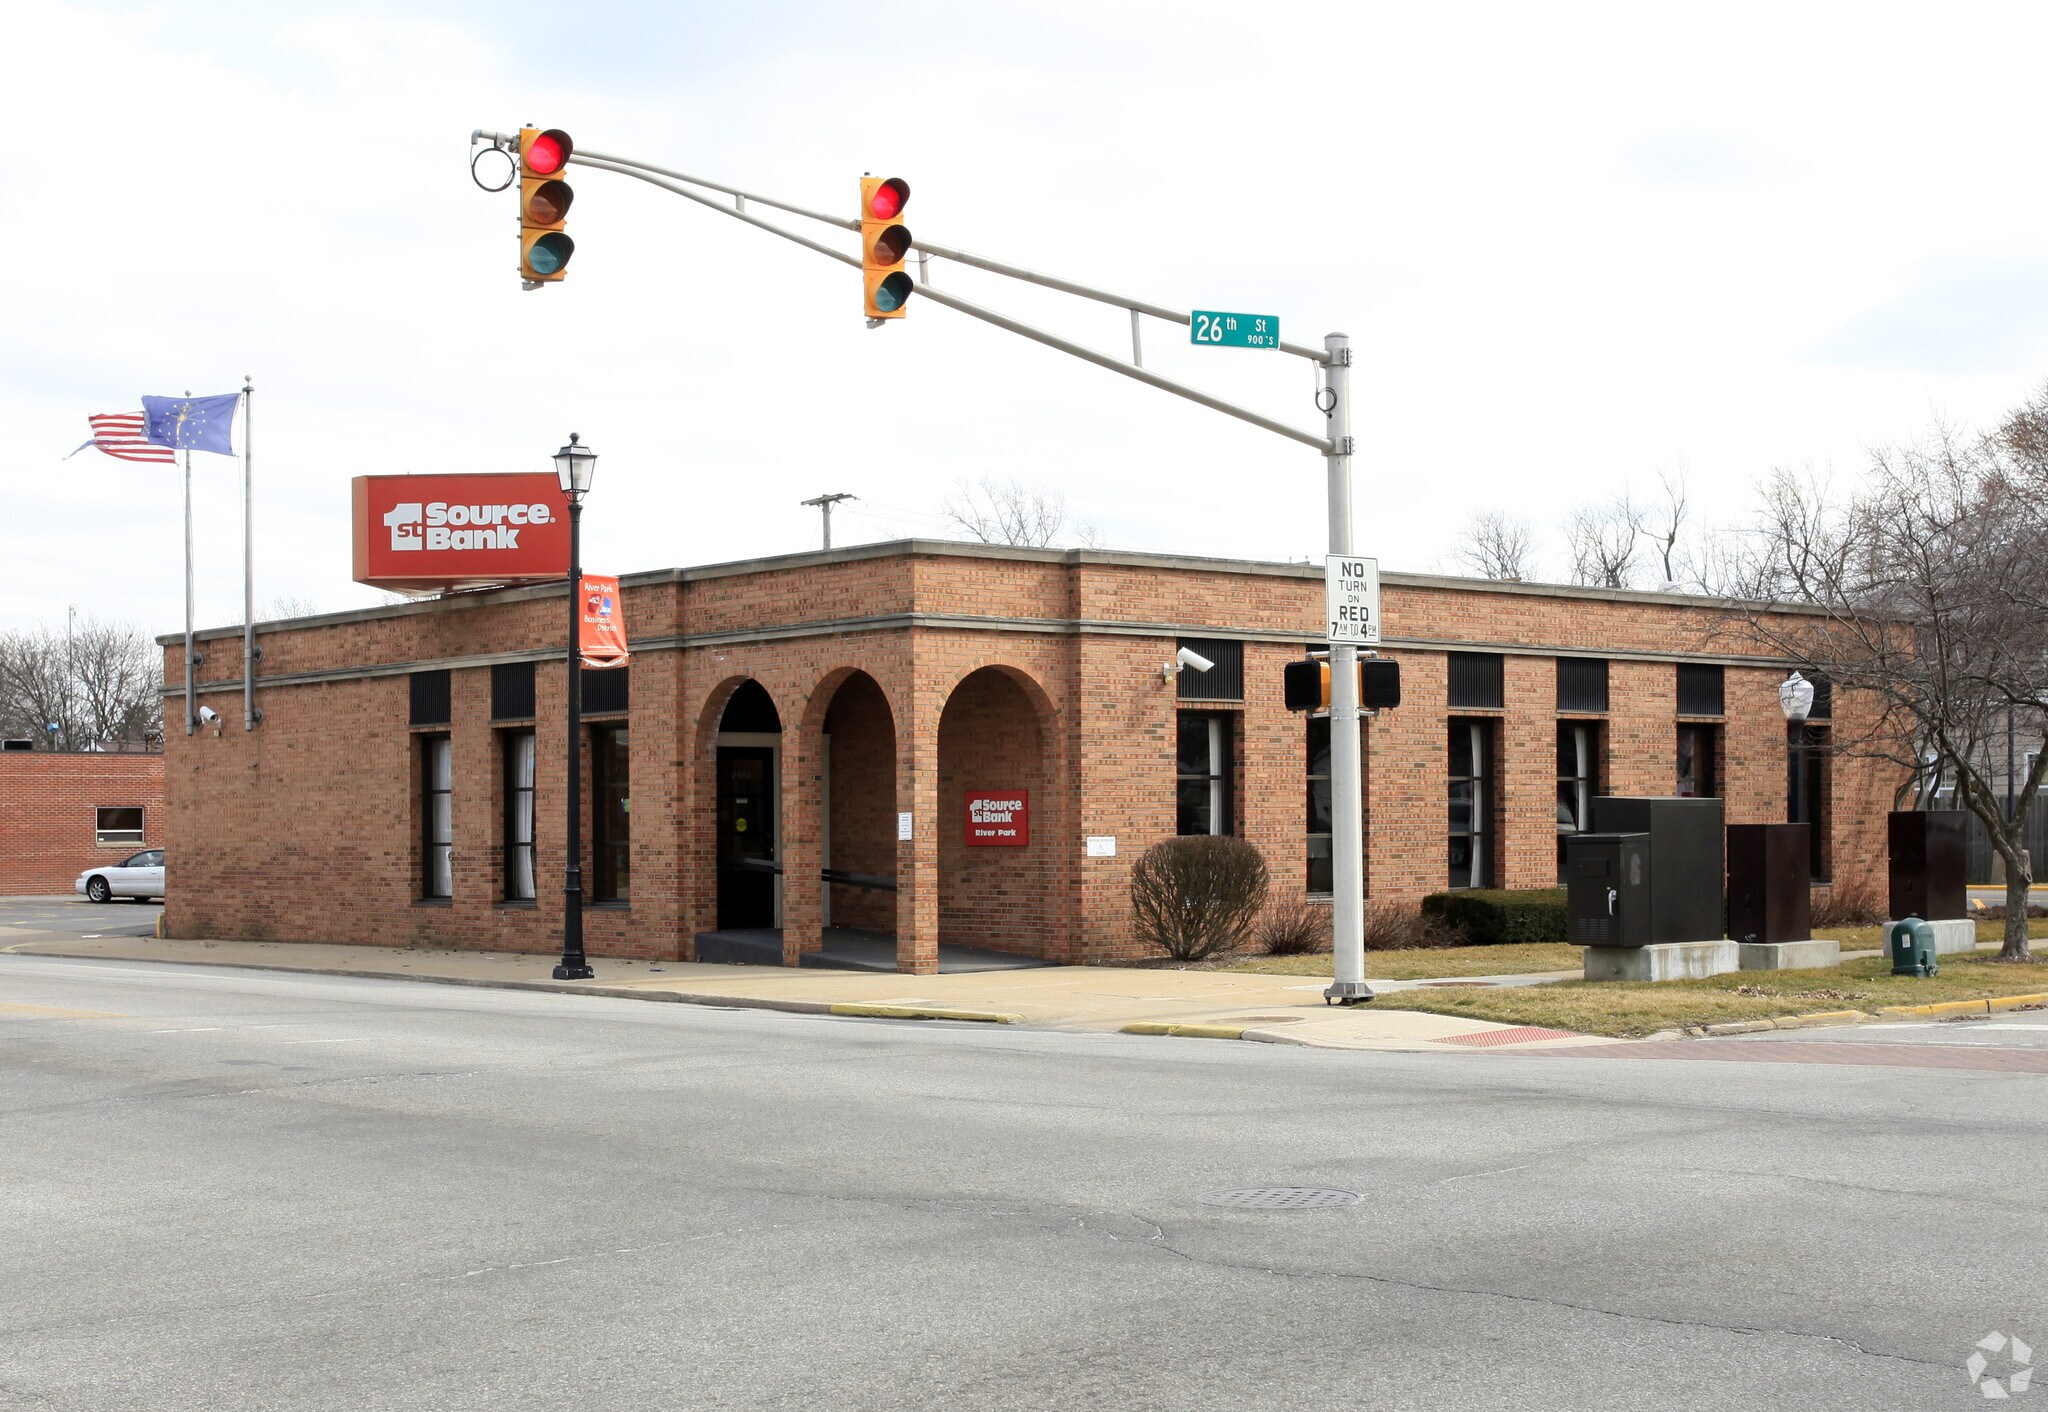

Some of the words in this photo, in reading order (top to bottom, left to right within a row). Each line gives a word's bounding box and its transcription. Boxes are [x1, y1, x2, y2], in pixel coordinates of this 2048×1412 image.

[1196, 315, 1237, 342] 26th
[1255, 319, 1267, 333] St
[1247, 335, 1263, 345] 900
[425, 501, 551, 526] Source
[426, 525, 520, 551] Bank
[1341, 562, 1364, 578] NO
[584, 582, 600, 592] River
[600, 584, 614, 593] Park
[1338, 579, 1367, 593] TURN
[1347, 594, 1360, 603] ON
[583, 614, 610, 624] Business
[1339, 605, 1369, 622] RED
[1331, 621, 1339, 637] 7
[1350, 623, 1359, 636] TO
[1360, 623, 1368, 639] 4
[982, 799, 1022, 811] Source
[982, 810, 1013, 823] Bank
[975, 829, 996, 837] River
[997, 828, 1017, 837] Park
